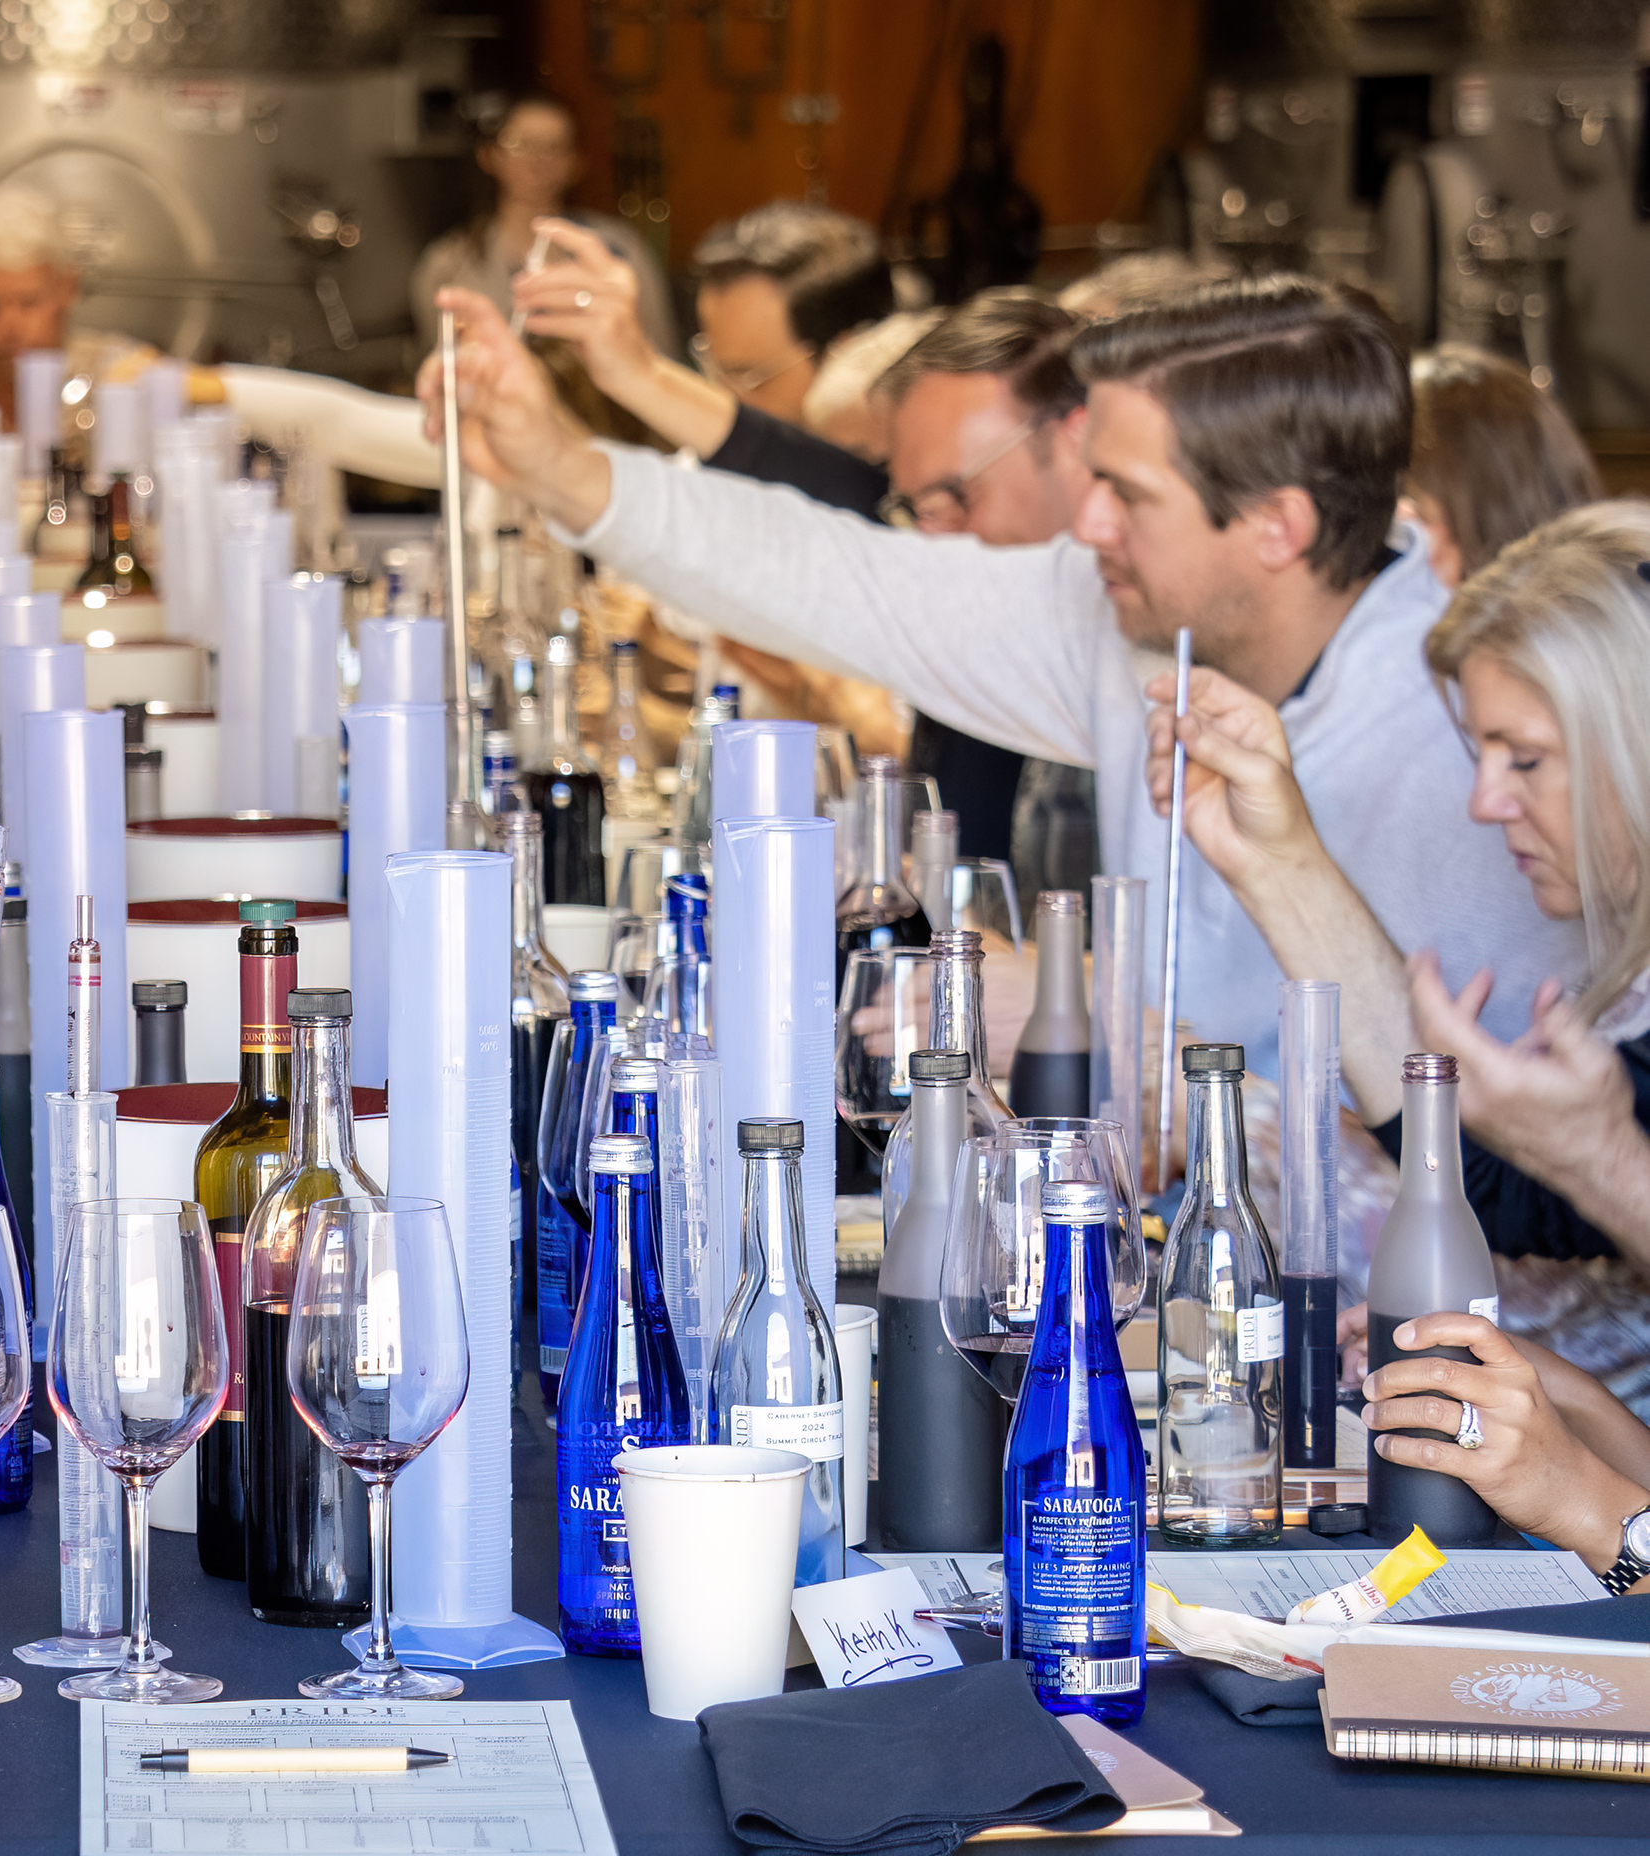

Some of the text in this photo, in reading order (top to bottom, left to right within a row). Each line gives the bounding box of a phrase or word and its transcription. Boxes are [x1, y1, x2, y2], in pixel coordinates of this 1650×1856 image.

[1242, 1313, 1255, 1359] PRIDE
[767, 1412, 811, 1420] CABERNET
[801, 1424, 825, 1432] 2024
[766, 1437, 798, 1445] SUMMIT
[800, 1436, 827, 1444] CIRCLE
[1032, 1515, 1130, 1528] A PERFECTLY refined TASTE
[1067, 1526, 1093, 1534] carefully
[1032, 1562, 1130, 1575] LIFE'S perfect PAIRING
[596, 1591, 632, 1601] SPRING
[604, 1608, 612, 1619] 12
[613, 1608, 621, 1619] FL
[822, 1618, 896, 1664] Keith
[1484, 1662, 1621, 1695] VINEYARDS
[1450, 1673, 1480, 1706] PRIDE
[250, 1706, 405, 1716] PRIDE
[1492, 1700, 1625, 1720] MOUNTAIN
